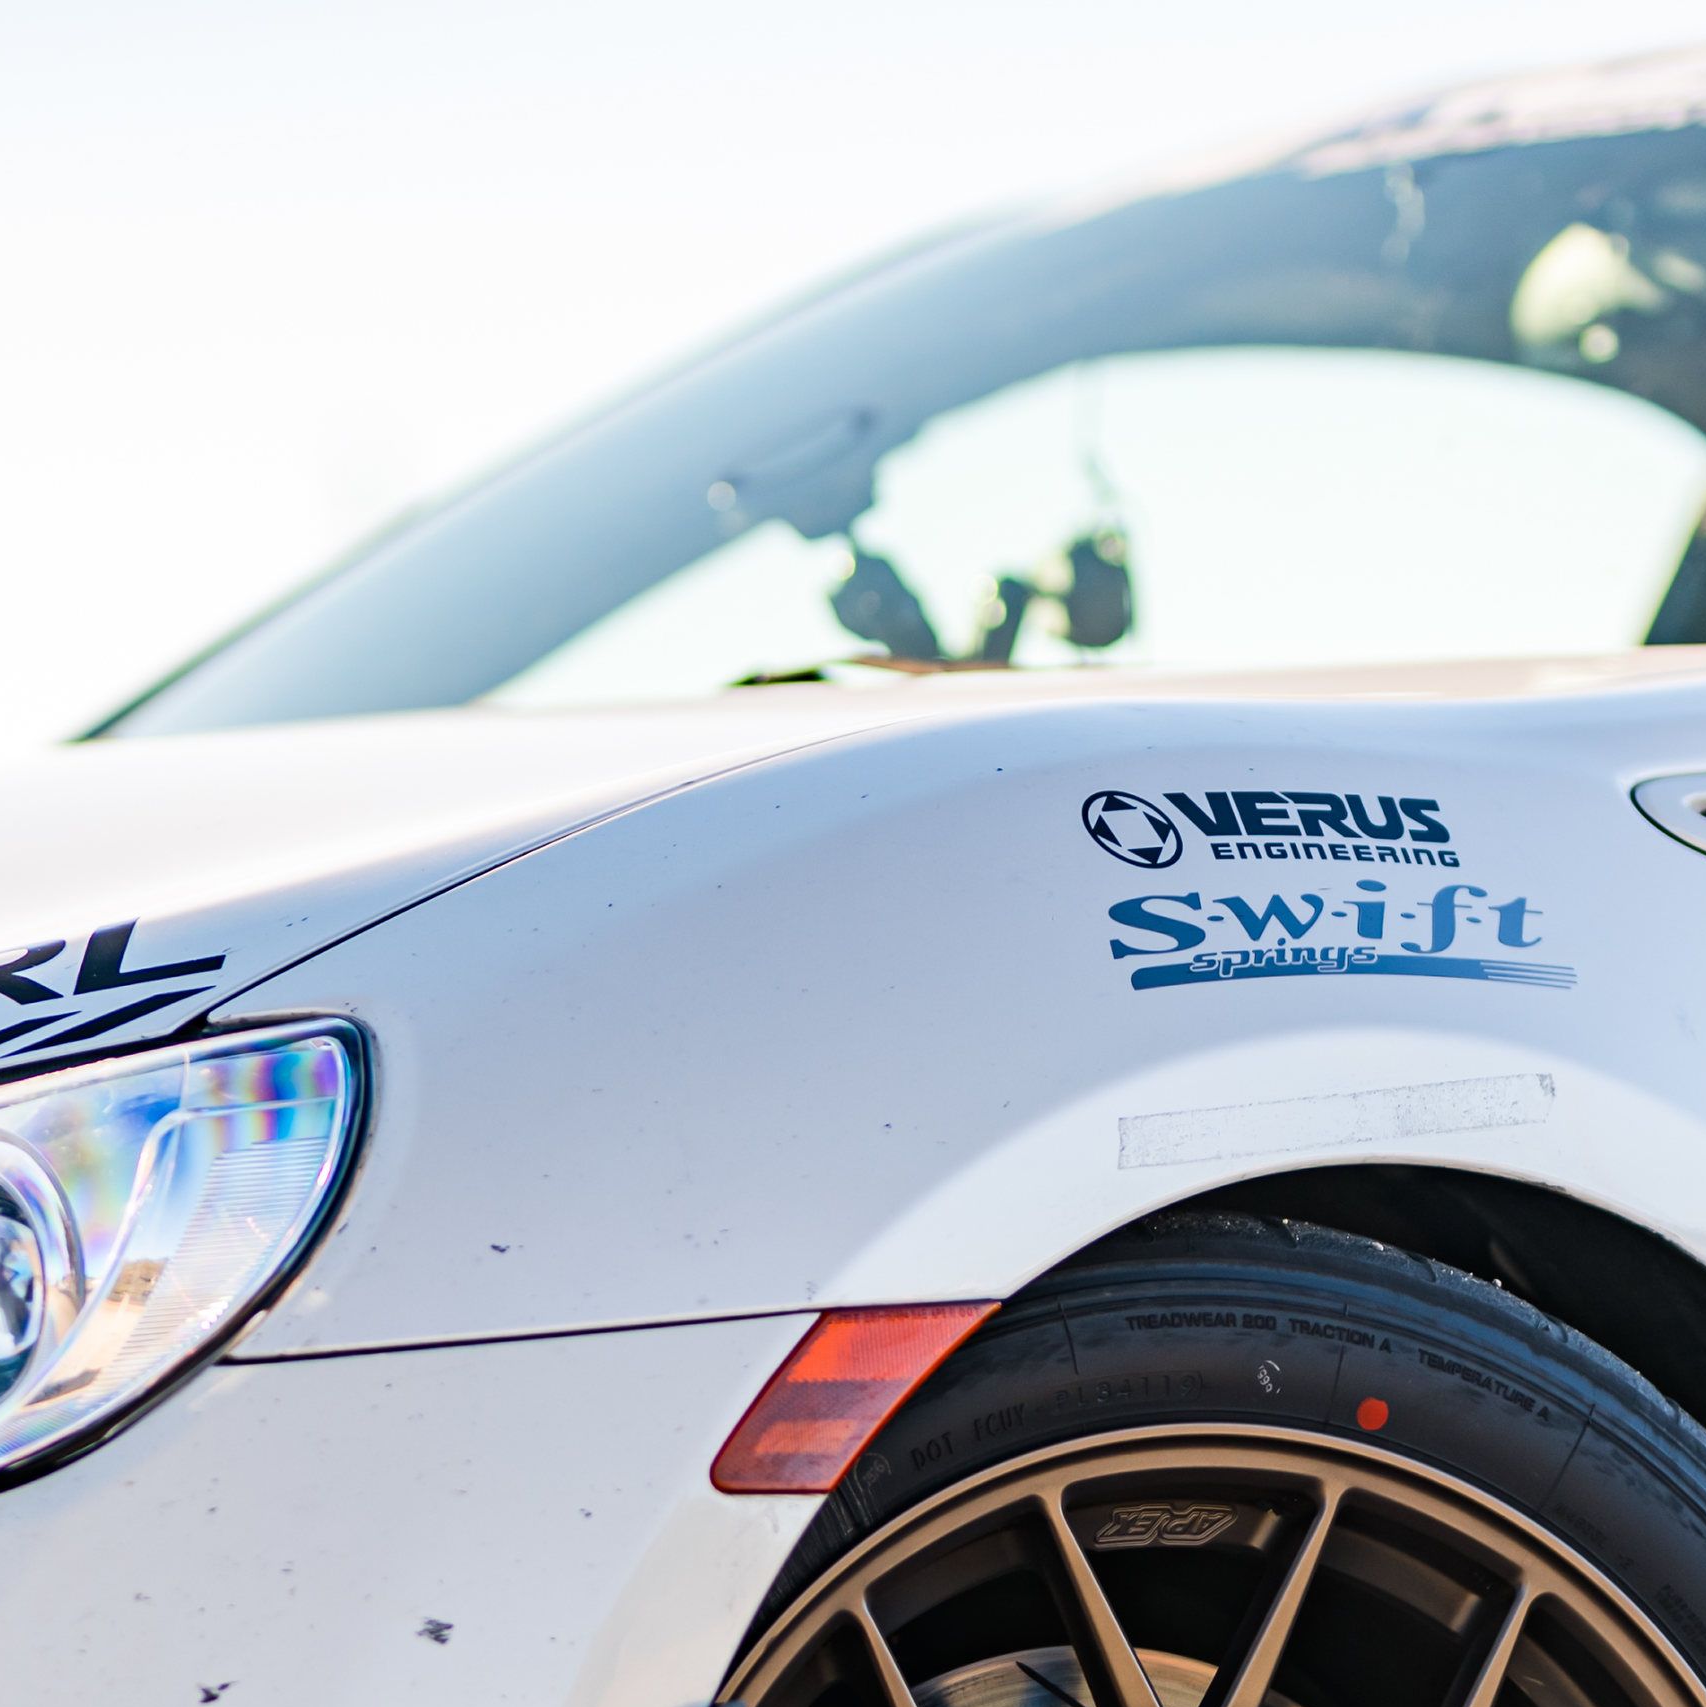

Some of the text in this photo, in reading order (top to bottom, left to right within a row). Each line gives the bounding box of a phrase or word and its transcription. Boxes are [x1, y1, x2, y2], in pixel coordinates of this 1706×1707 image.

[1162, 791, 1450, 843] VERUS
[1214, 842, 1461, 868] ENGINEERING
[1191, 937, 1378, 976] springs
[1124, 1314, 1238, 1330] TREADWEAR
[1287, 1318, 1375, 1349] TRACTION
[1413, 1347, 1538, 1413] TEMPERATURE
[909, 1430, 956, 1472] DOT
